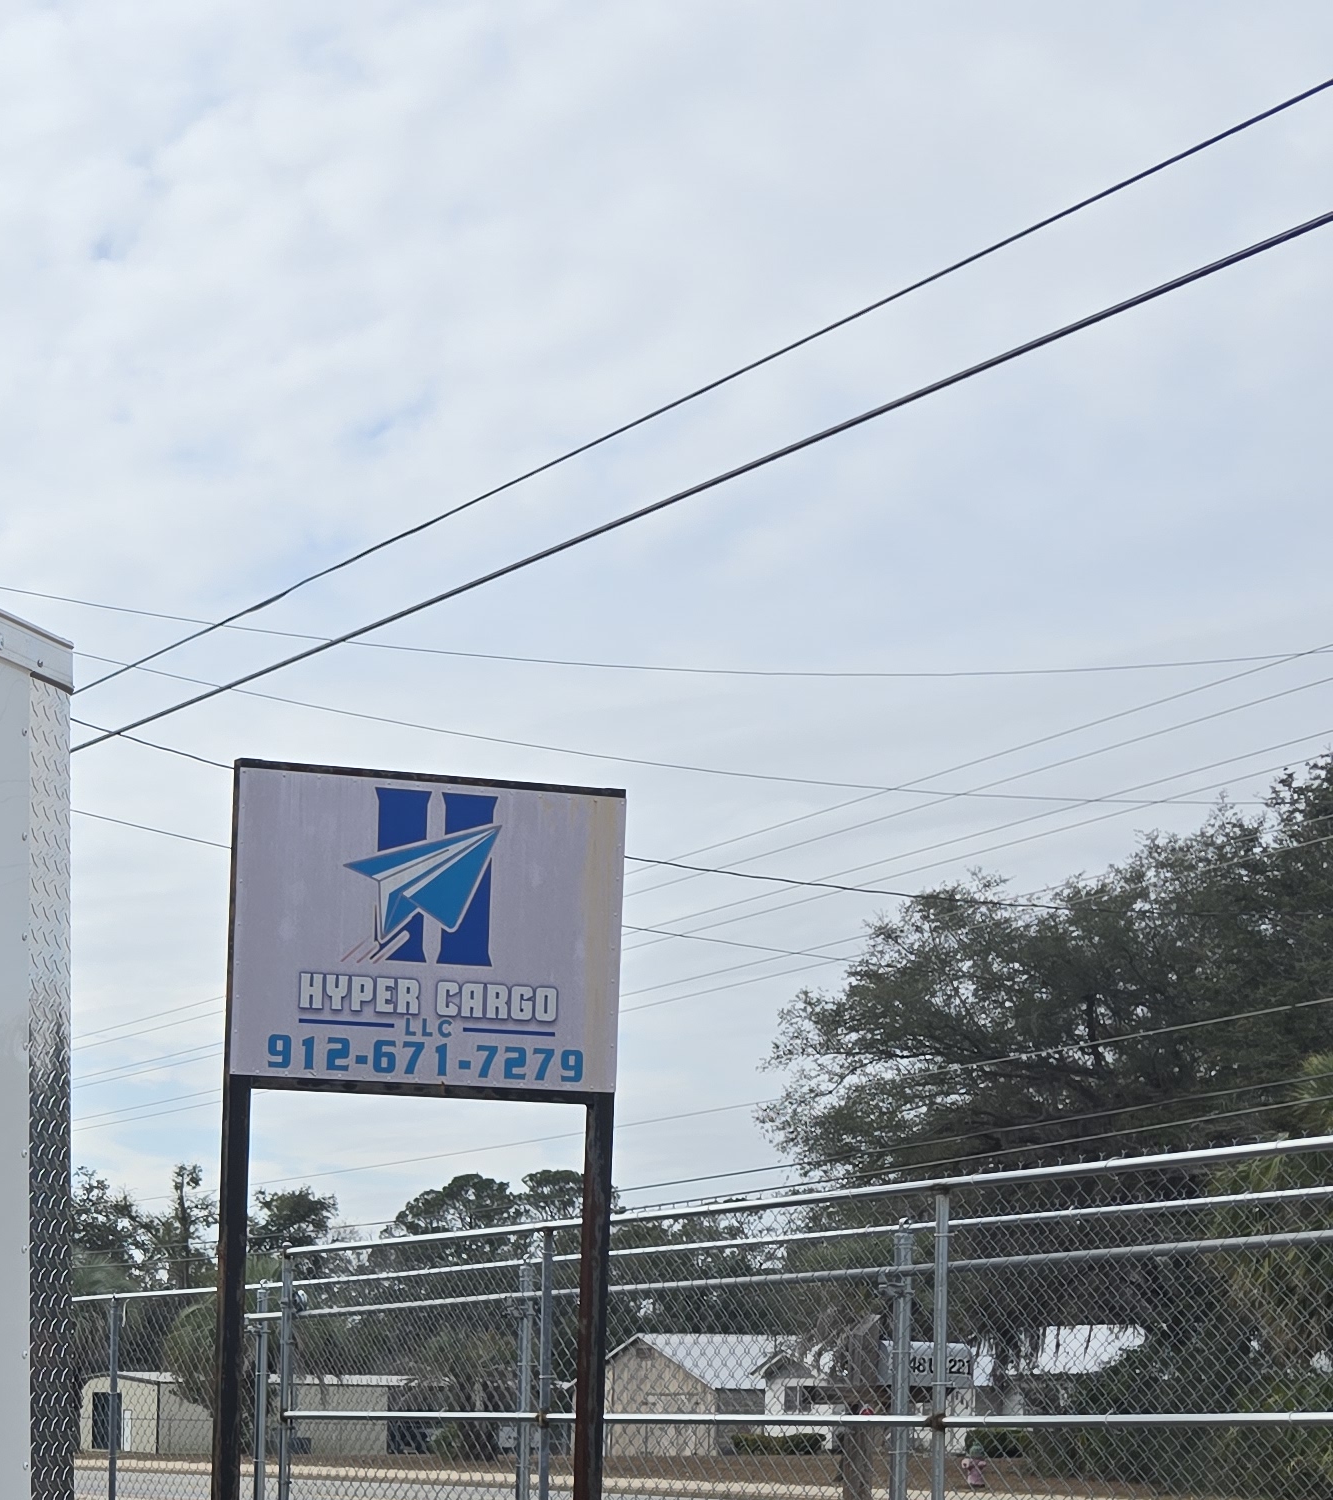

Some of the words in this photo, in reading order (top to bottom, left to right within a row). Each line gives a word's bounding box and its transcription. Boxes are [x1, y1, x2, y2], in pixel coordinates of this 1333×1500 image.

[298, 972, 421, 1016] HYPER
[435, 979, 559, 1023] CARGO
[404, 1017, 453, 1039] LLC
[267, 1033, 584, 1084] 912-671-7279
